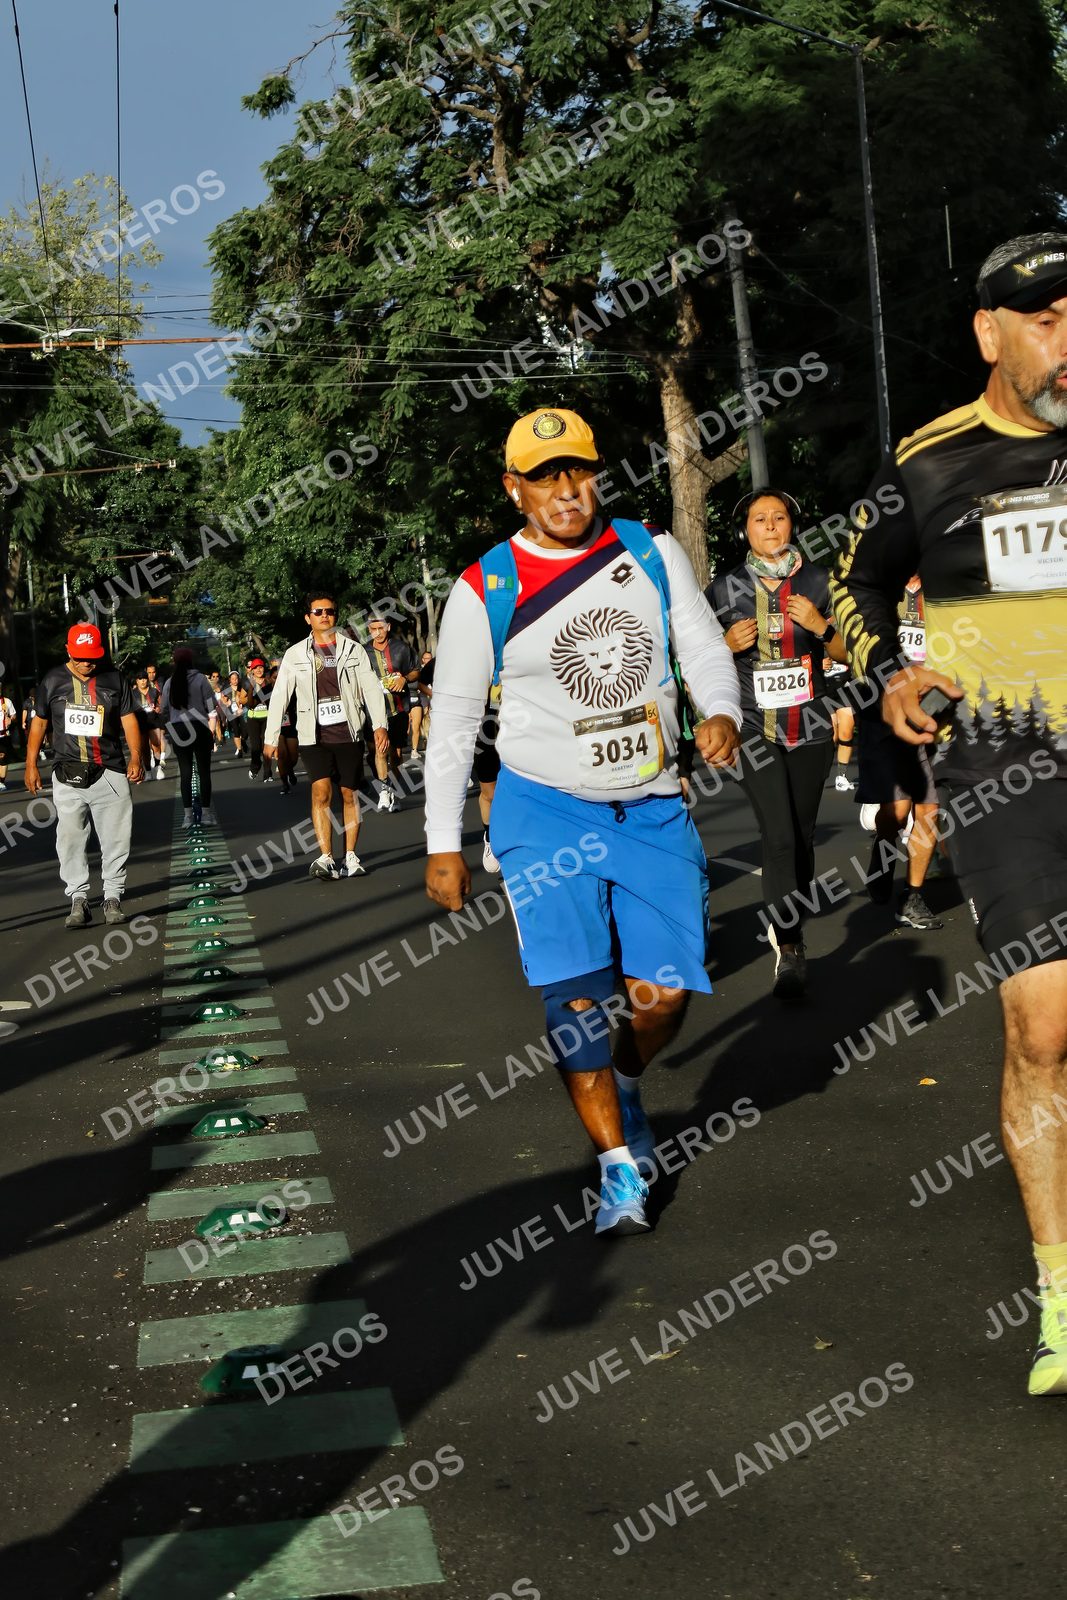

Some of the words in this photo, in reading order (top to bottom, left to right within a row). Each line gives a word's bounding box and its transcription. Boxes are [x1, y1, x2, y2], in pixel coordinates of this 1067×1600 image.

[757, 672, 806, 692] 12826
[320, 704, 342, 716] 5183
[69, 713, 95, 726] 6503
[591, 731, 649, 767] 3034
